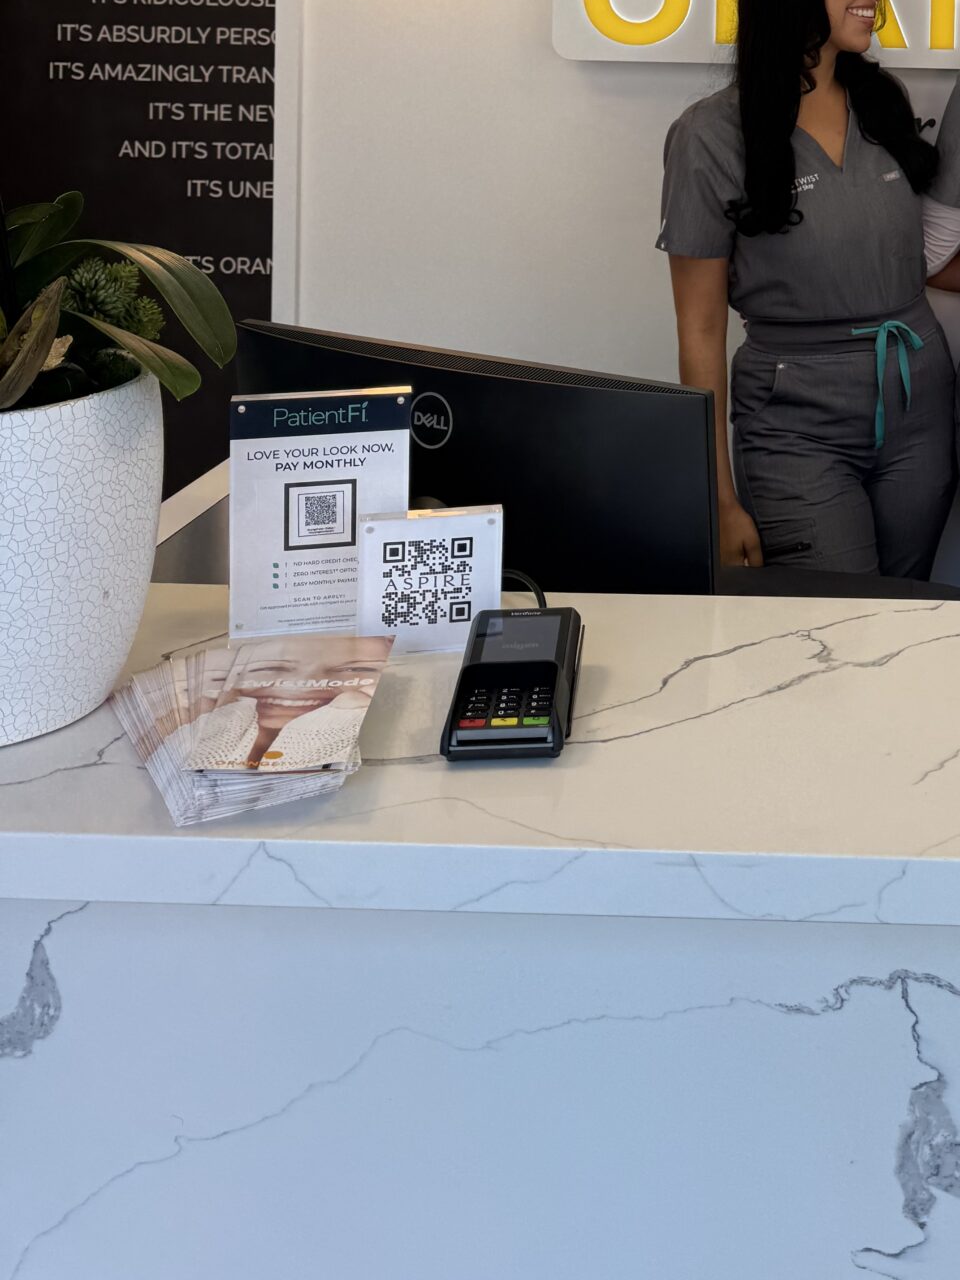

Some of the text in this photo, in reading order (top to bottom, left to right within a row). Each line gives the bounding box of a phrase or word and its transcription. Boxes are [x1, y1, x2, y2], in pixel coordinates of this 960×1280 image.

[57, 24, 92, 42] IT'S
[97, 25, 210, 45] ABSURDLY
[49, 62, 84, 80] IT'S
[89, 64, 214, 83] AMAZINGLY
[149, 102, 275, 122] IT'S THE NE
[118, 140, 166, 158] AND
[172, 141, 208, 159] IT'S
[187, 180, 223, 198] IT'S
[414, 411, 448, 430] DELL
[247, 443, 394, 461] LOVE YOUR LOOK NOW,
[275, 457, 366, 472] PAY MONTHLY
[384, 574, 471, 591] ASPIRE
